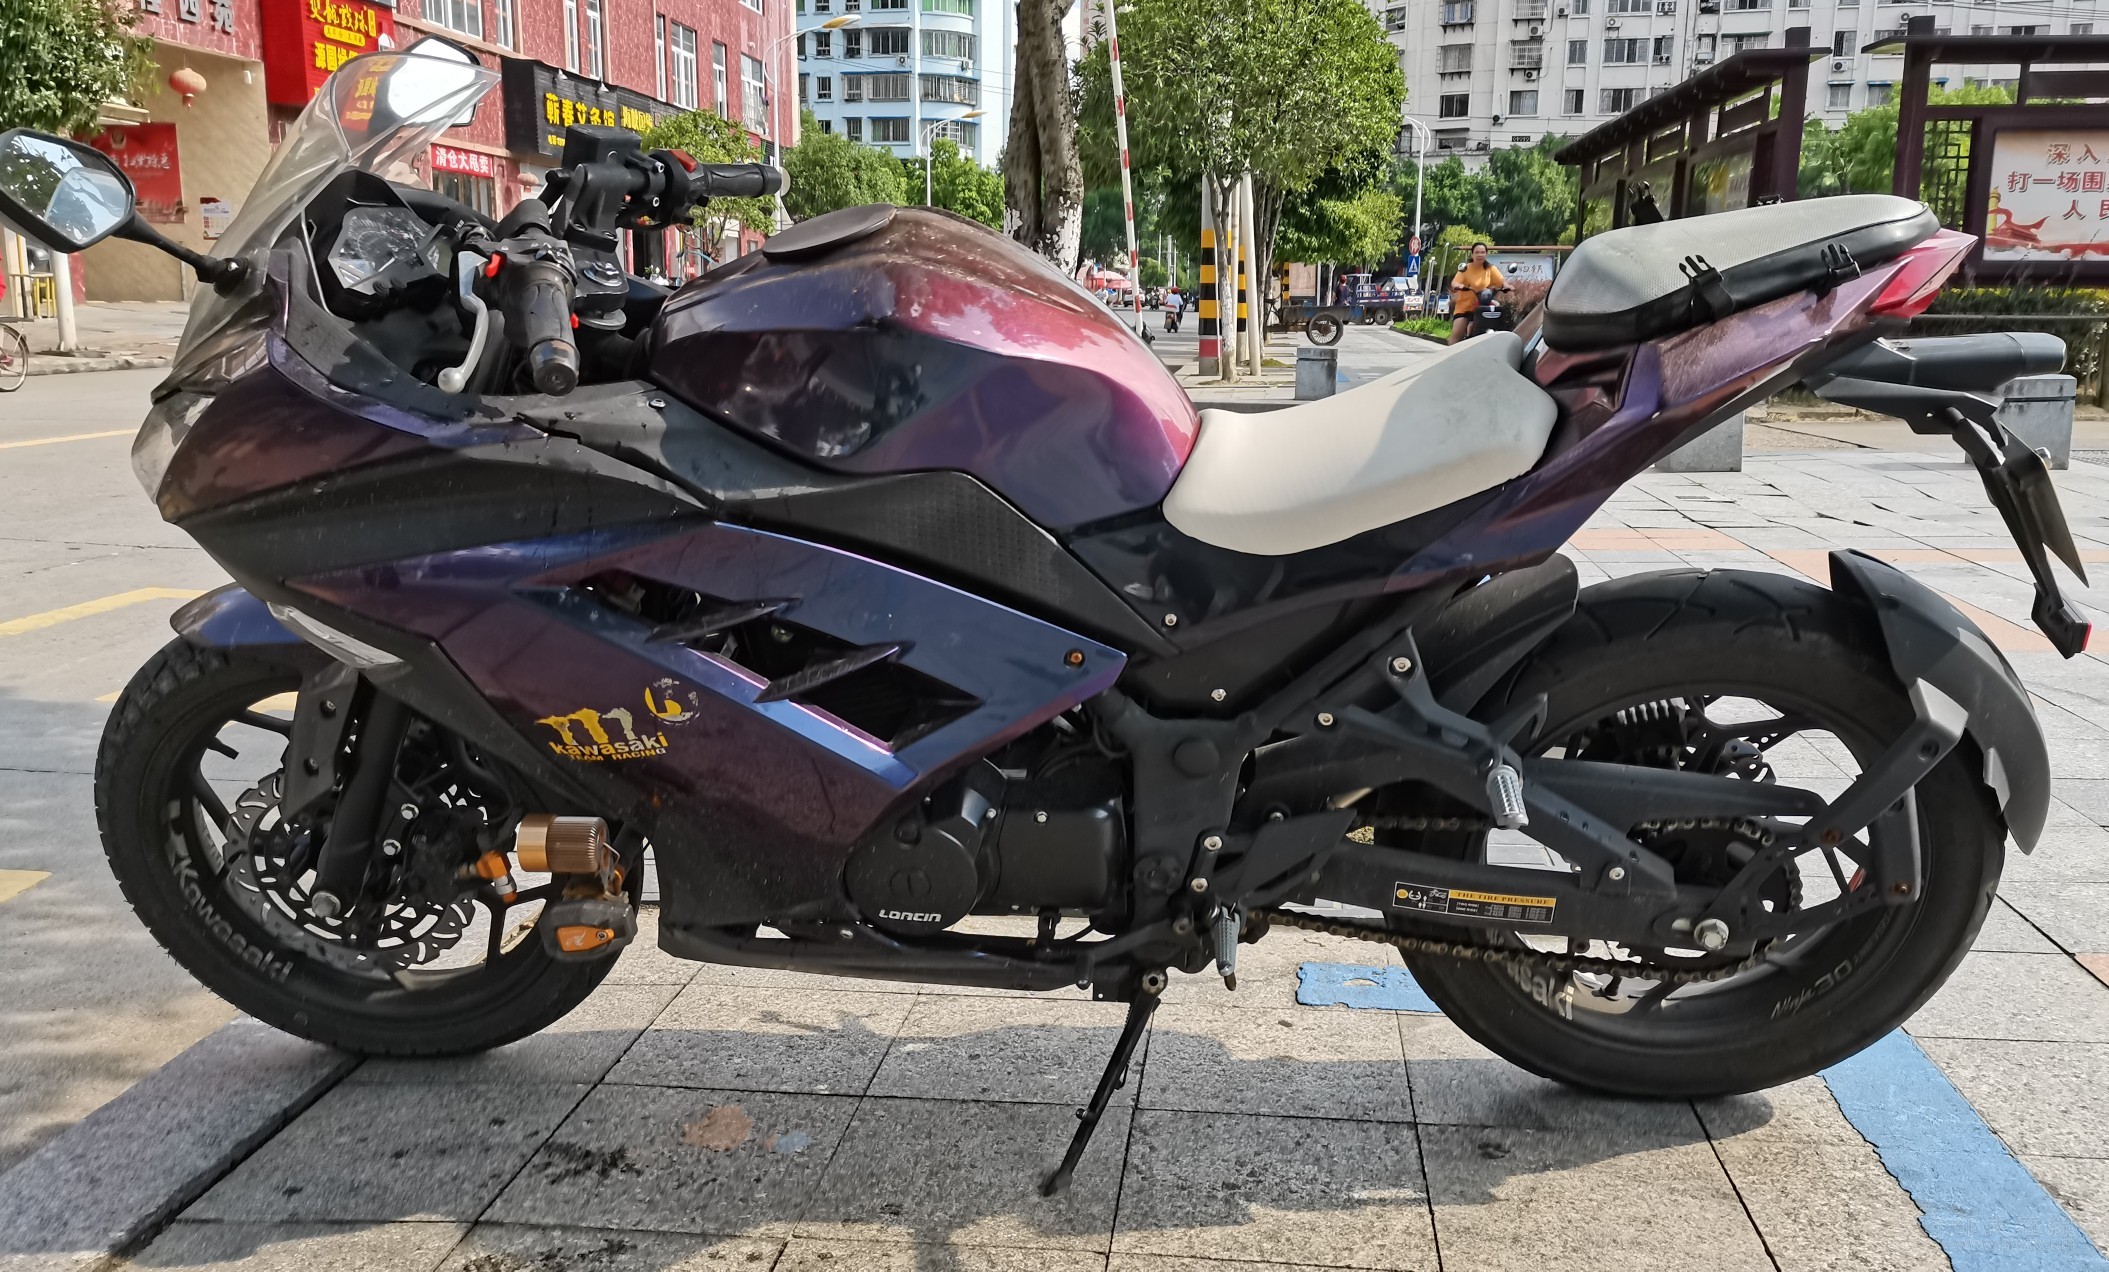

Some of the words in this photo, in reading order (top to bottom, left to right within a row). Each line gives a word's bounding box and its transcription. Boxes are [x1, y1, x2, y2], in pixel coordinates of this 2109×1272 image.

[435, 146, 489, 174] 清仓大甩卖
[2047, 143, 2109, 165] 深入
[2008, 170, 2109, 193] 打一场围
[611, 748, 667, 761] RACING
[1457, 891, 1474, 899] THE
[1477, 893, 1497, 901] TIRE
[1501, 896, 1549, 905] PRESSURE
